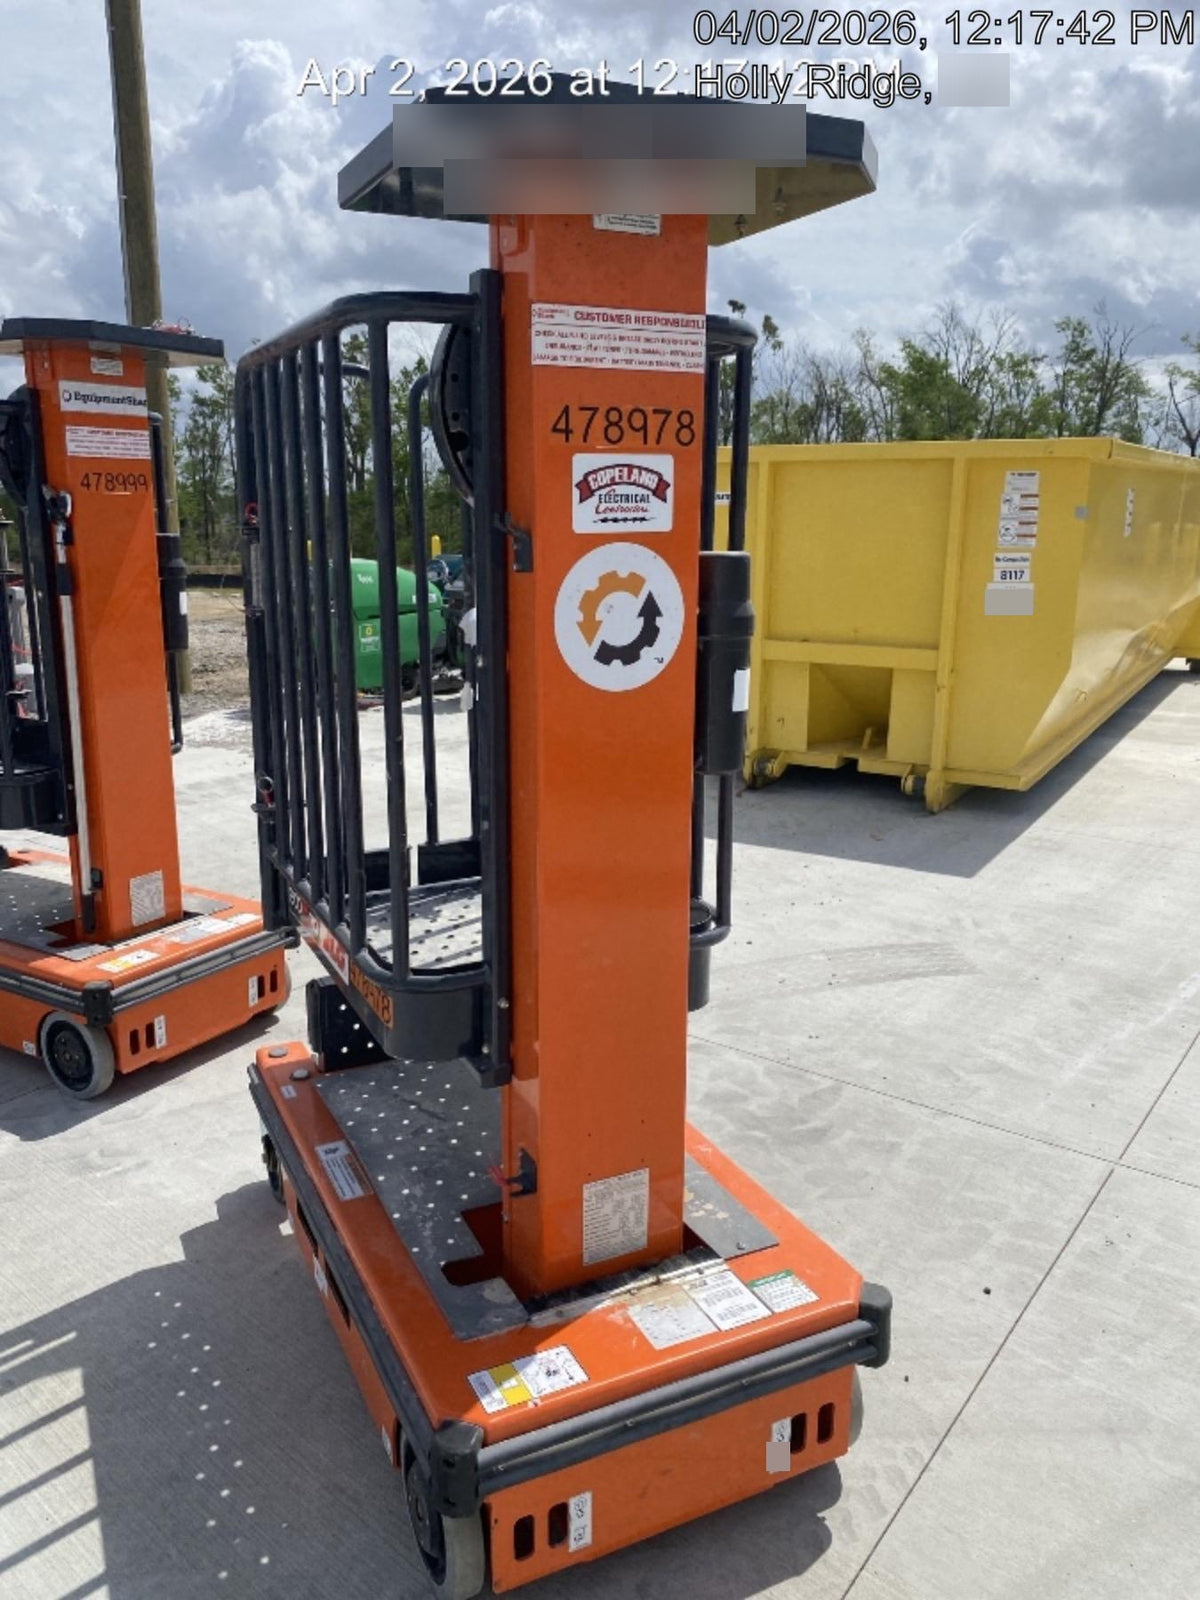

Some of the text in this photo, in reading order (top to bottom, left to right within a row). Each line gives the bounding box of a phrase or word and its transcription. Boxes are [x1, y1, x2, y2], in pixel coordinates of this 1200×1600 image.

[573, 309, 631, 324] CUSTOMER
[551, 404, 696, 447] 478978
[80, 472, 148, 493] 478999
[587, 466, 659, 490] COPELAND
[598, 493, 651, 504] ELECTRICAL
[1000, 570, 1025, 581] 8117
